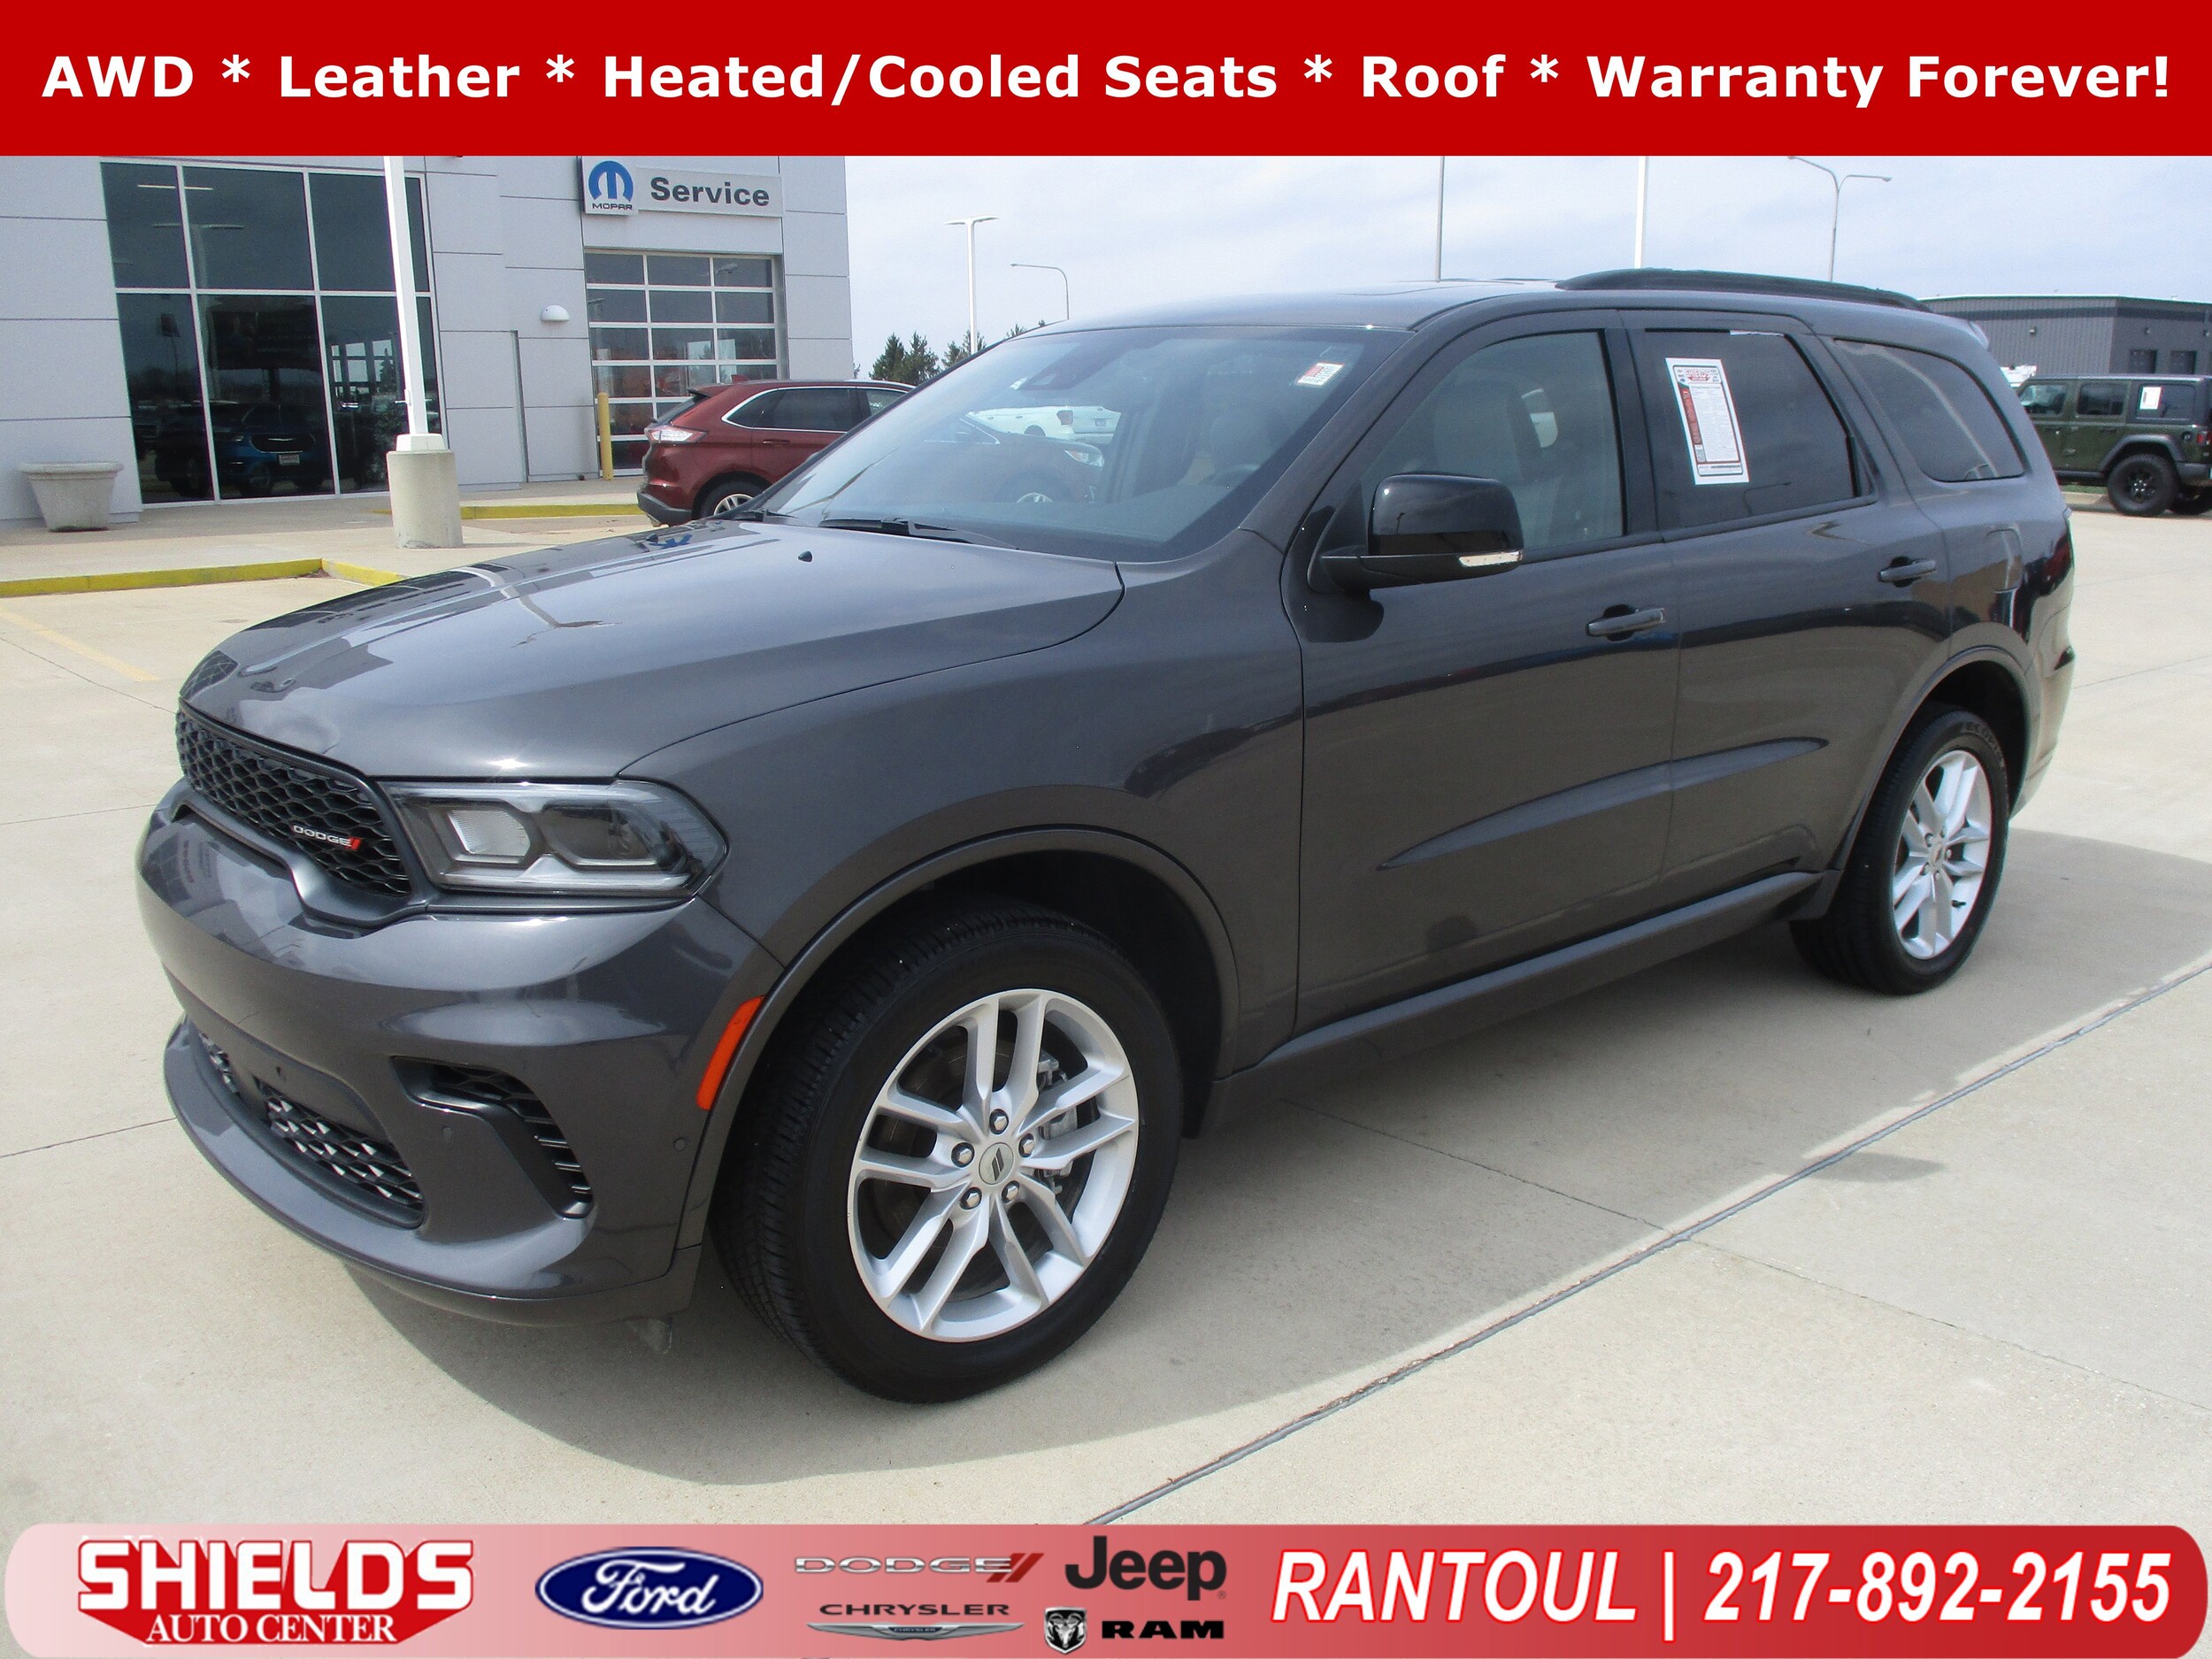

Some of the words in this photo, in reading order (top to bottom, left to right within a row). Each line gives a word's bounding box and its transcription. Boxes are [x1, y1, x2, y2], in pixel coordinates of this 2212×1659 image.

[650, 176, 770, 207] Service
[592, 202, 634, 211] MOPAR
[293, 825, 352, 847] DODGE
